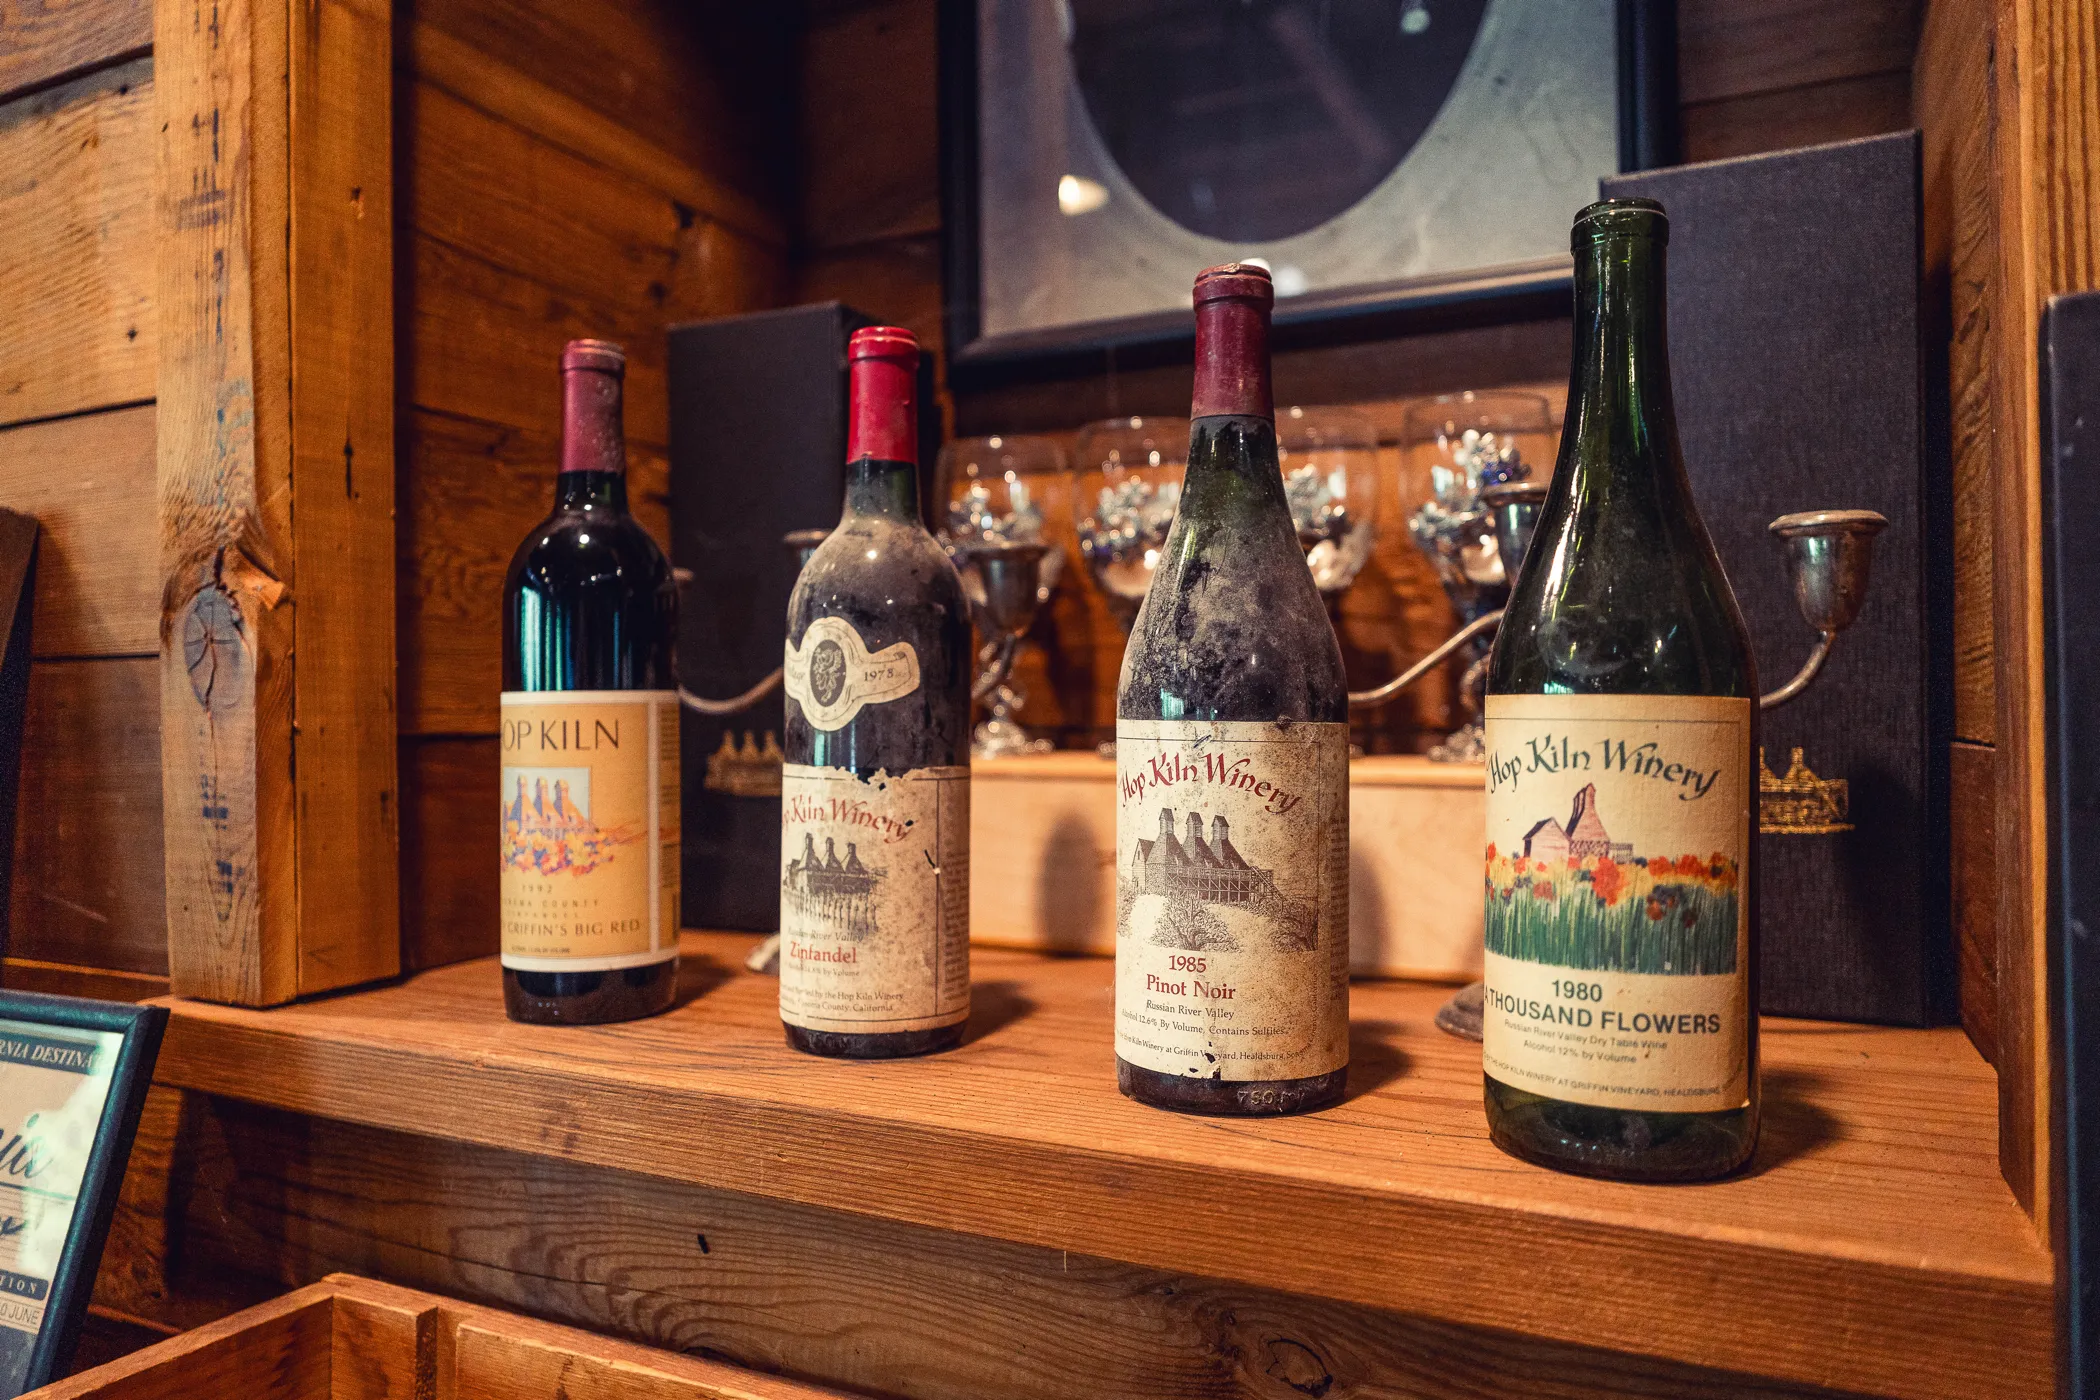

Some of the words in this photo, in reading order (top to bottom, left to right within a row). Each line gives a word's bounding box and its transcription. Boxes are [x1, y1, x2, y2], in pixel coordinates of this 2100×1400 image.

[501, 719, 532, 752] OP
[541, 719, 619, 751] KILN
[1486, 750, 1522, 794] Hop
[1524, 733, 1592, 774] Kiln
[1596, 737, 1722, 802] Winery
[1122, 769, 1146, 807] Hop
[1147, 752, 1199, 788] Kiln
[1201, 752, 1301, 815] Winery
[791, 794, 825, 823] Kiln
[827, 797, 914, 844] Winery
[542, 899, 600, 908] COUNTY
[575, 922, 604, 938] BIG
[610, 919, 642, 936] RED
[790, 941, 858, 964] Zinfandel
[1168, 954, 1207, 973] 1985
[833, 968, 860, 977] Volume
[837, 991, 854, 1001] Hop
[856, 992, 873, 1001] Kiln
[874, 991, 904, 1001] Winery
[1146, 973, 1187, 997] Pinot
[1193, 980, 1237, 1000] Noir
[1551, 979, 1604, 1004] 1980
[852, 1001, 894, 1013] California
[1146, 999, 1176, 1014] Russian
[1178, 1006, 1202, 1017] River
[1205, 1007, 1235, 1020] Valley
[1489, 987, 1593, 1028] THOUSAND
[1600, 1010, 1721, 1034] FLOWERS
[1139, 1014, 1158, 1027] 12.6%
[1160, 1018, 1170, 1031] By
[1172, 1021, 1206, 1035] Volume,
[1208, 1025, 1250, 1036] Contains
[1504, 1019, 1533, 1034] Russian
[1534, 1025, 1556, 1039] River
[1557, 1030, 1588, 1046] Valley
[1589, 1035, 1608, 1049] Dry
[1611, 1037, 1639, 1050] Table
[1641, 1039, 1668, 1050] Wine
[31, 1044, 95, 1068] DESTINA
[1142, 1039, 1165, 1053] Winery
[1165, 1046, 1172, 1054] at
[1173, 1046, 1199, 1058] Griffin
[1524, 1039, 1556, 1055] Alcohol
[1558, 1045, 1580, 1058] 12%
[1581, 1048, 1595, 1062] by
[1597, 1050, 1638, 1064] Volume
[1526, 1070, 1557, 1084] WINERY
[1558, 1078, 1570, 1087] AT
[1570, 1080, 1609, 1092] GRIFFIN
[1236, 1089, 1276, 1105] 750
[0, 1302, 8, 1317] 0
[8, 1304, 41, 1326] JUNE
